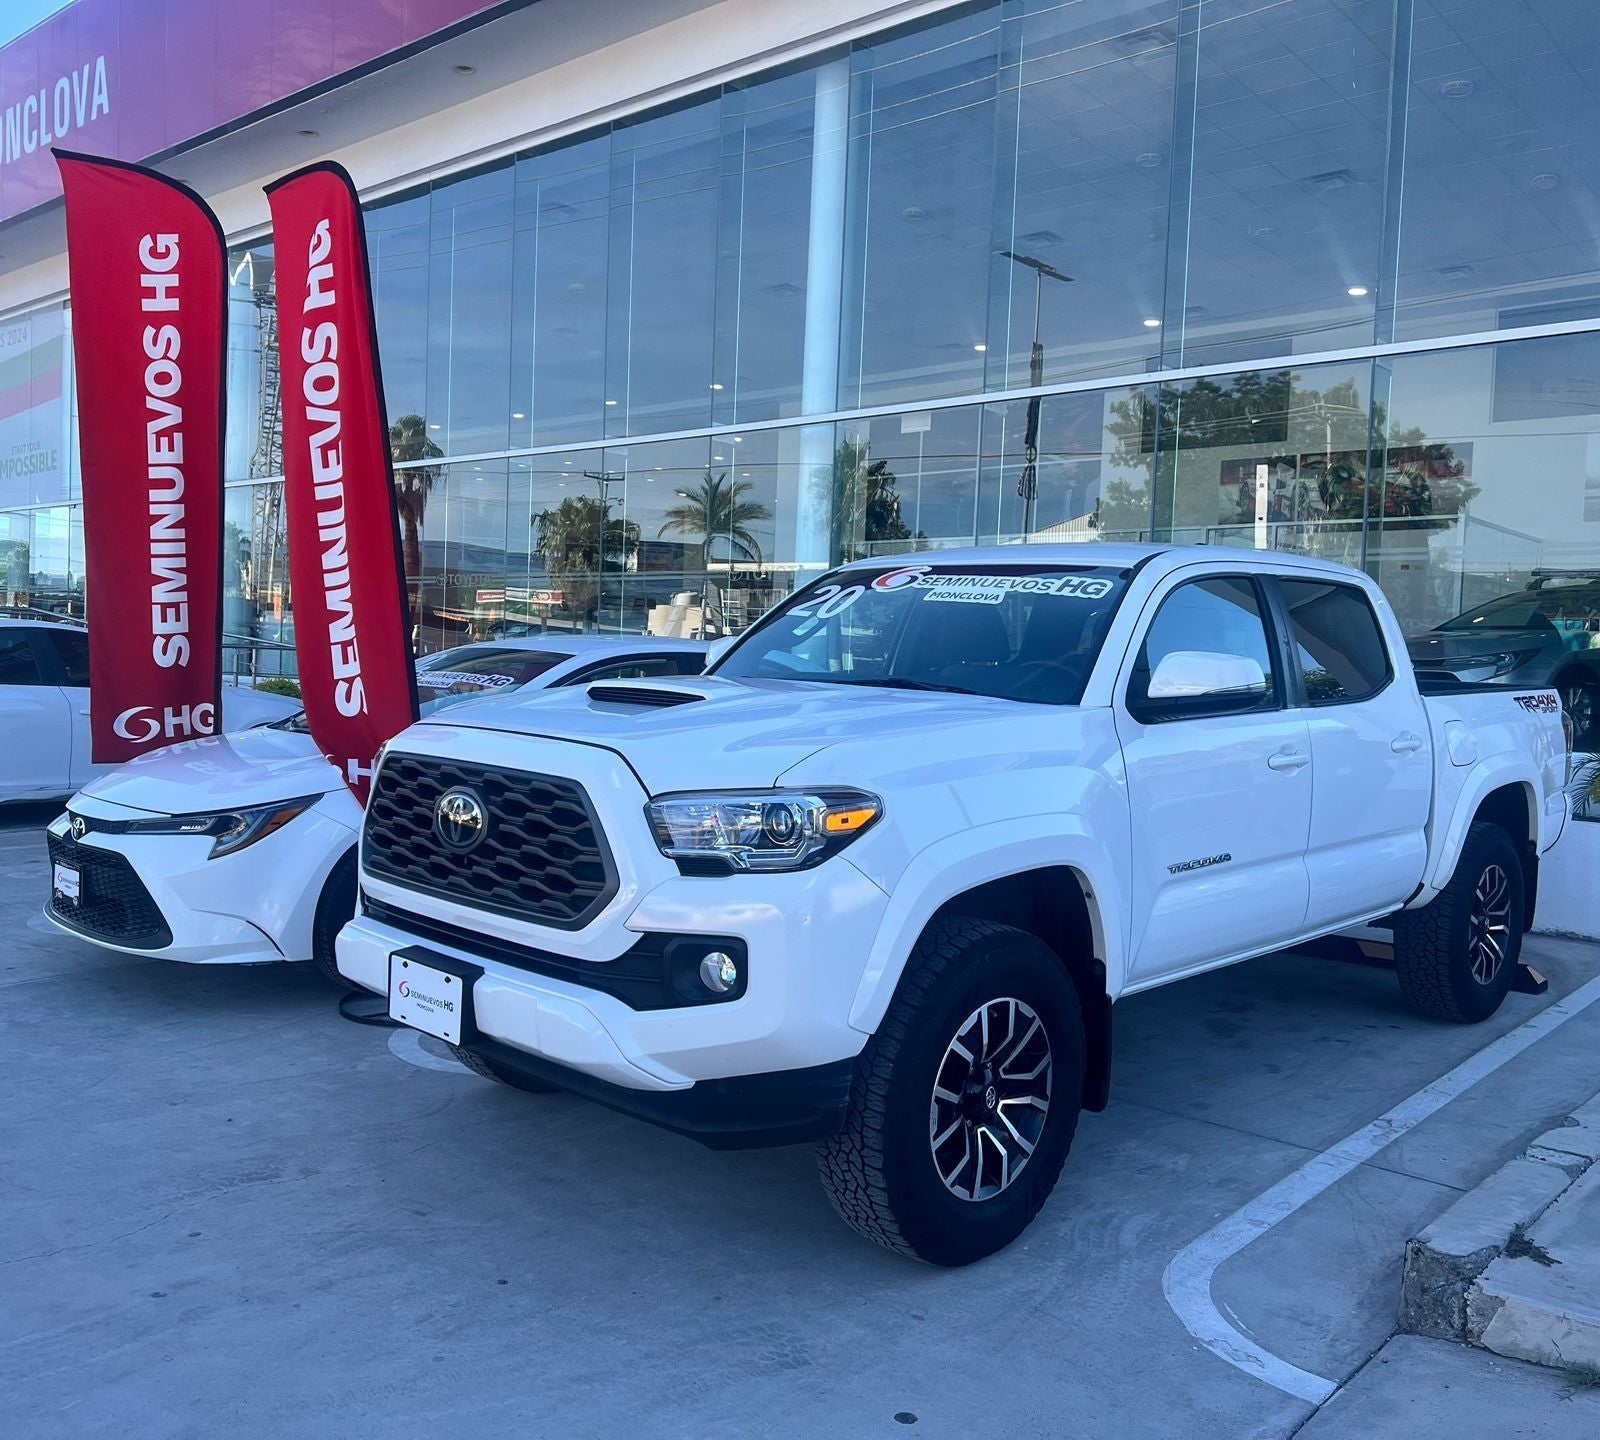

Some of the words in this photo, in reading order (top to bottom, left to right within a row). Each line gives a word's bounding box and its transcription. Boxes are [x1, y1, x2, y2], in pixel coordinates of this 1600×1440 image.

[0, 55, 109, 164] NCLOVA
[139, 233, 180, 312] HG
[143, 325, 190, 668] SEMINUEVOS
[301, 321, 368, 718] SEMINUEVOS
[448, 574, 492, 587] TOYOTA
[918, 576, 1053, 591] SEMINUEVOS
[1056, 578, 1108, 596] HG
[928, 591, 1000, 602] MONCLOVA
[483, 674, 508, 687] HG
[164, 703, 214, 737] HG
[411, 990, 443, 1009] SEMINUEVOS
[443, 1000, 454, 1012] HG
